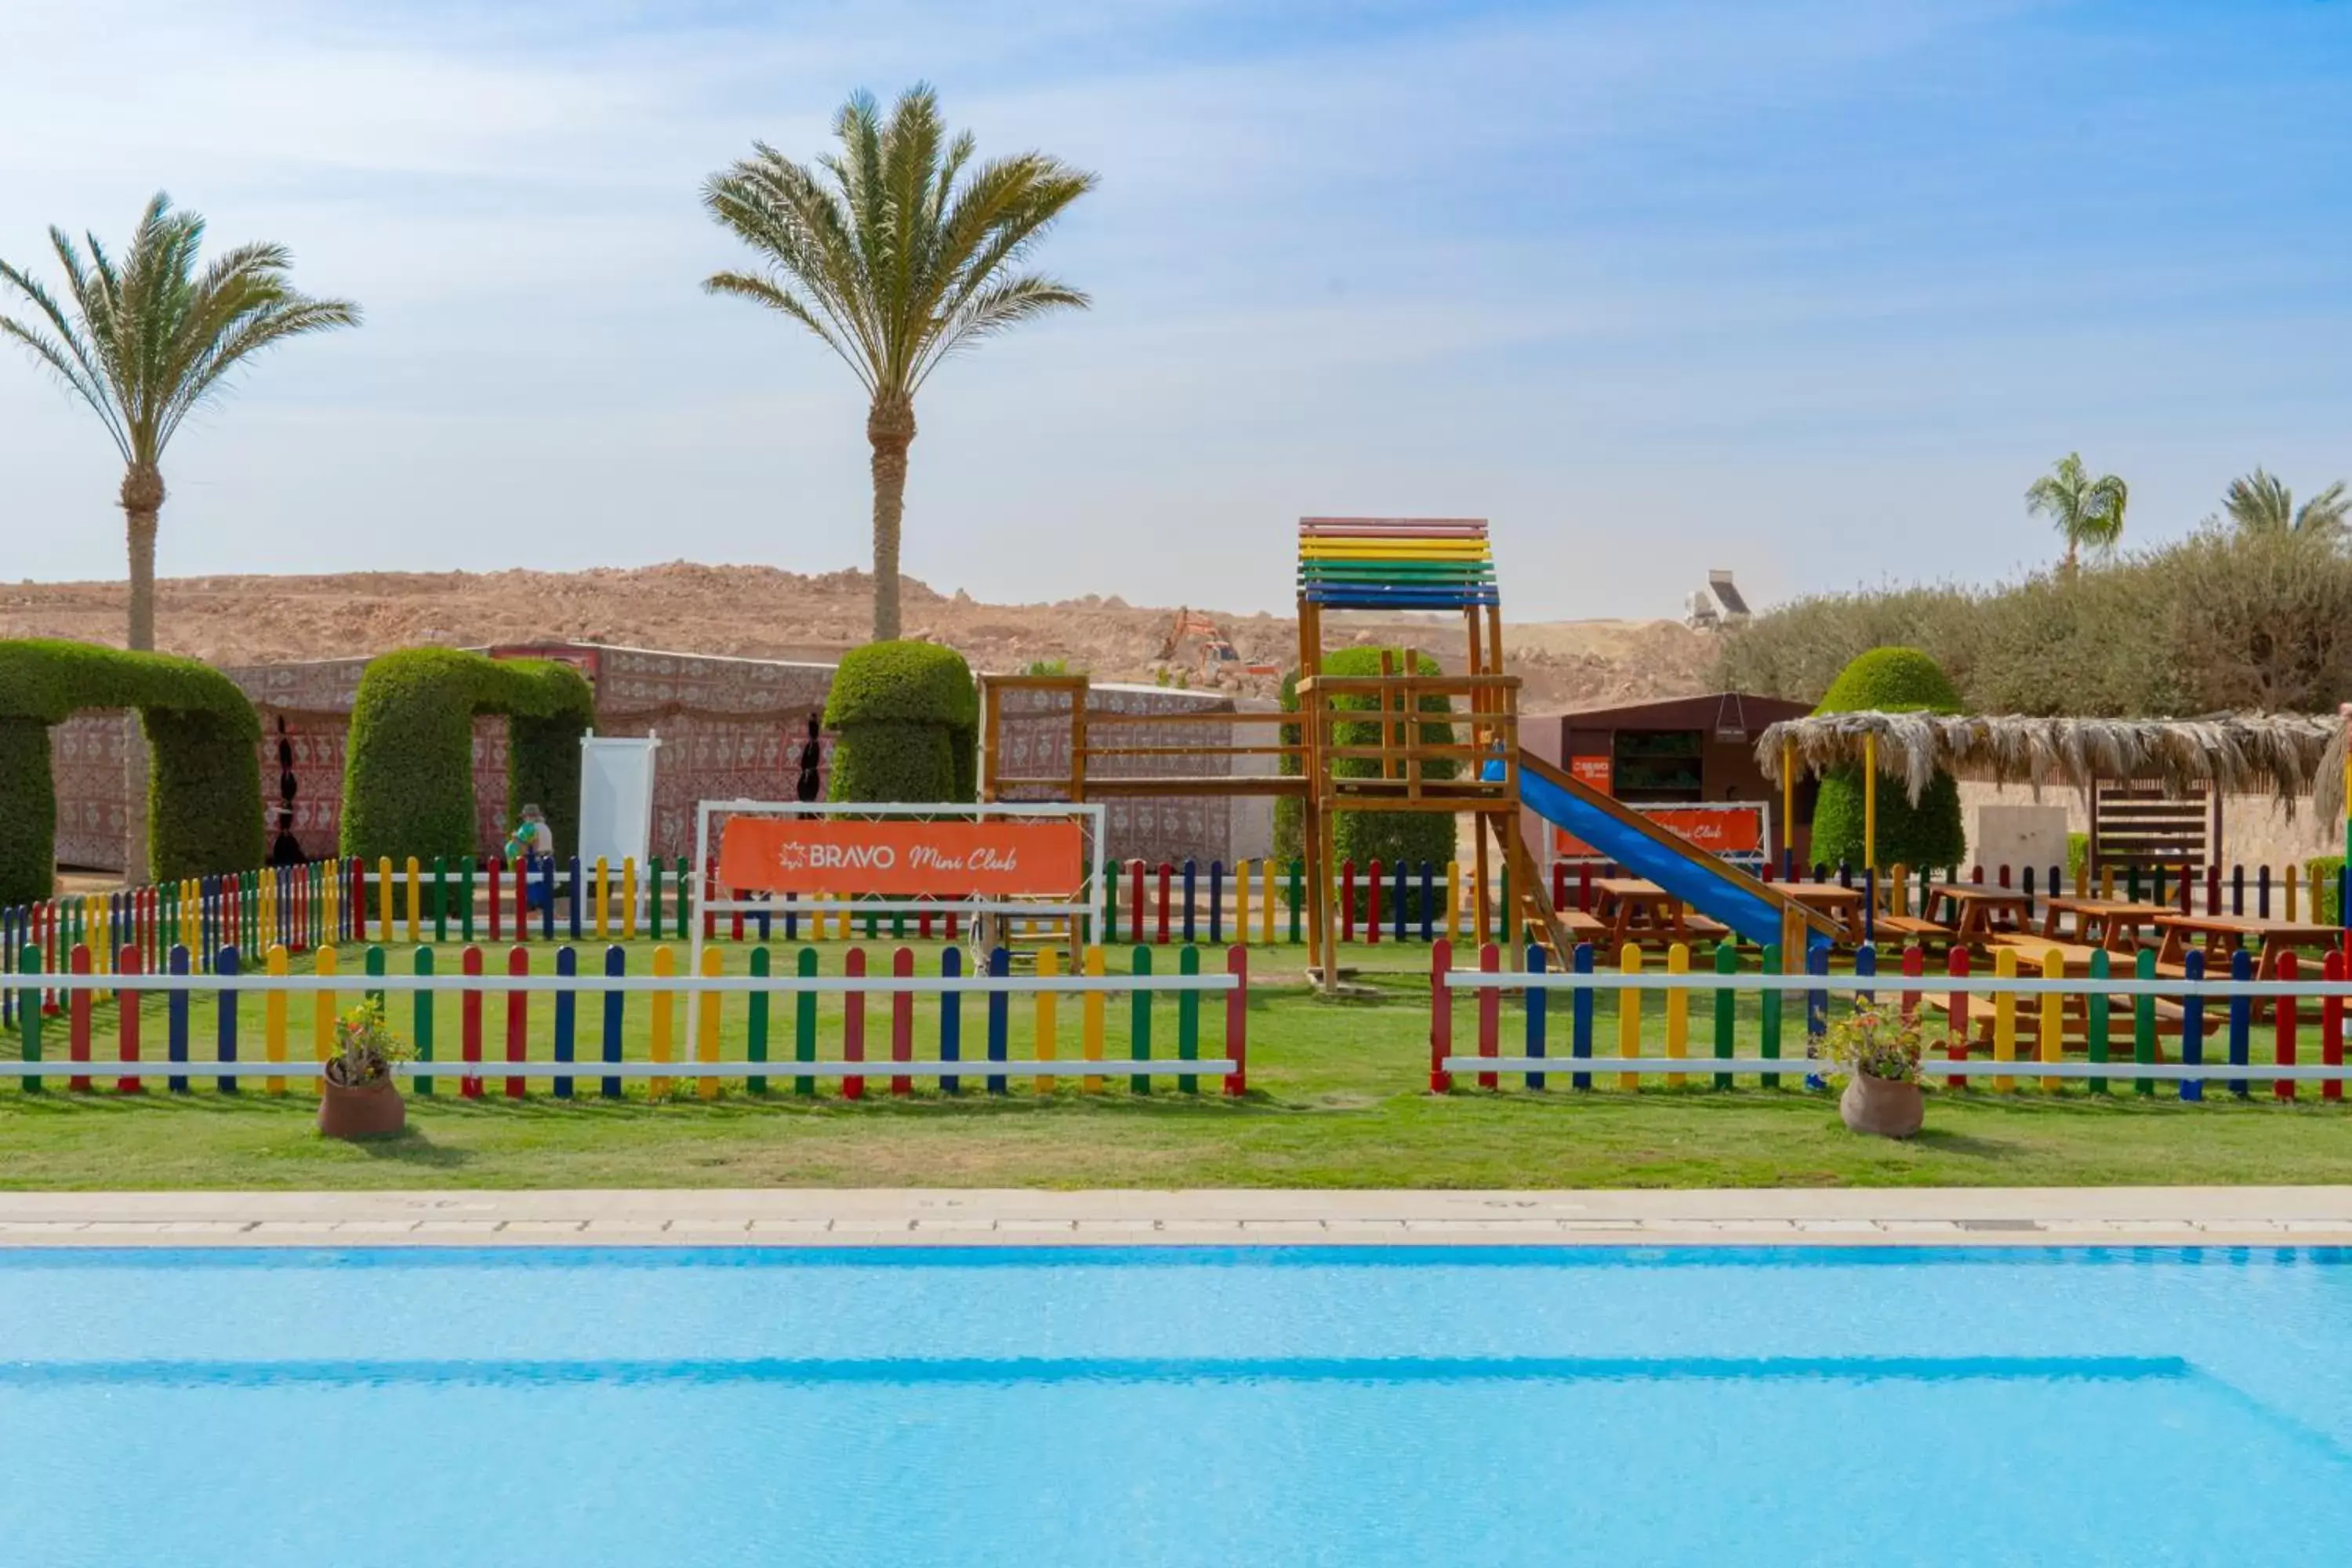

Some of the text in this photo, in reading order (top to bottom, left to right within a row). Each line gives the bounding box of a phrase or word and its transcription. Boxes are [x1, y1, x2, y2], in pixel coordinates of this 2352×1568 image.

[810, 844, 1017, 871] BRAVO Mini Club
